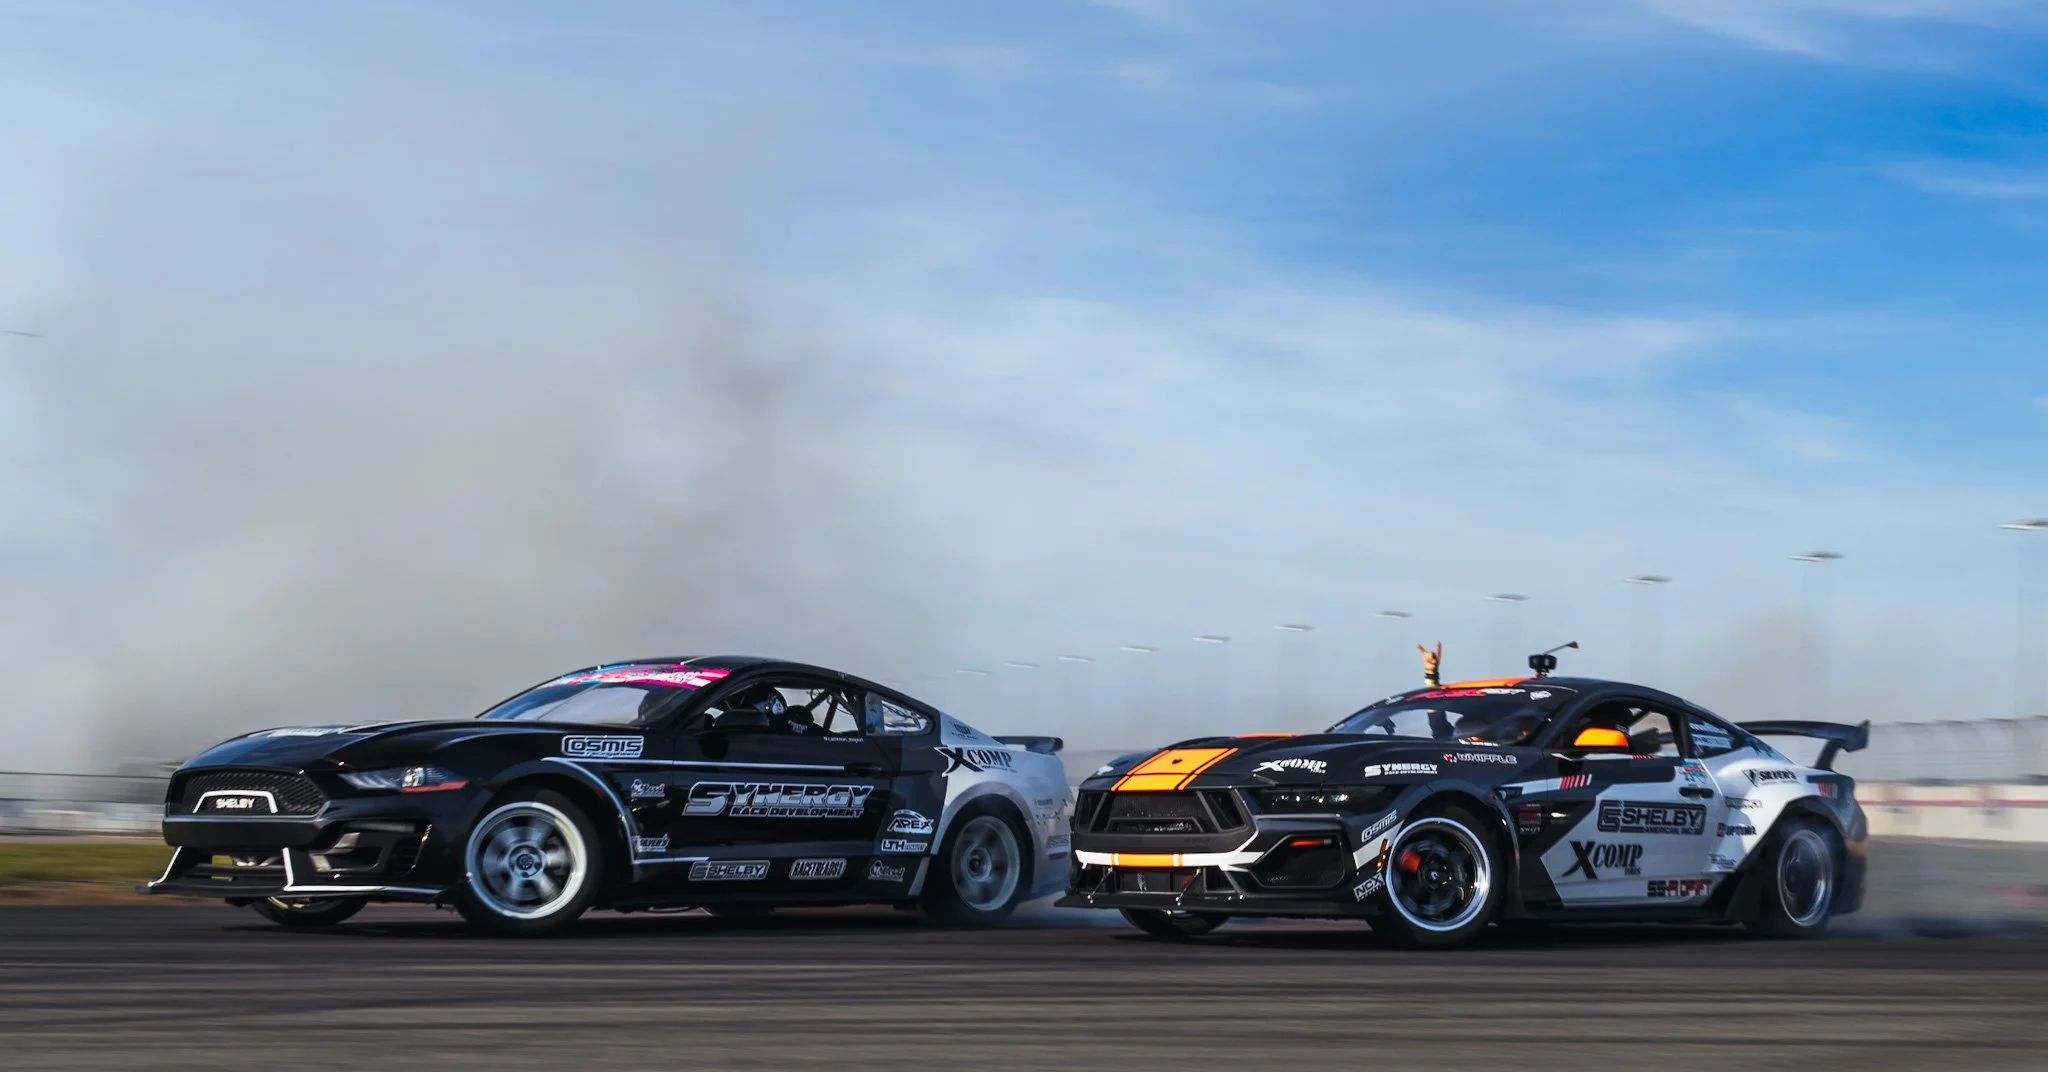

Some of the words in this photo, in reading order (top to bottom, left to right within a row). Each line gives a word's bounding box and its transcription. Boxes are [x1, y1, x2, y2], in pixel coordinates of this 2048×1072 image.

[1364, 763, 1437, 777] SYNERGY
[216, 798, 255, 808] SHELBY
[683, 781, 874, 816] SYNERGY
[734, 807, 768, 818] RACE
[770, 807, 864, 819] DEVELOPMENT
[1621, 808, 1701, 826] SHELBY
[708, 864, 767, 876] SHELBY
[1354, 873, 1385, 897] NCX
